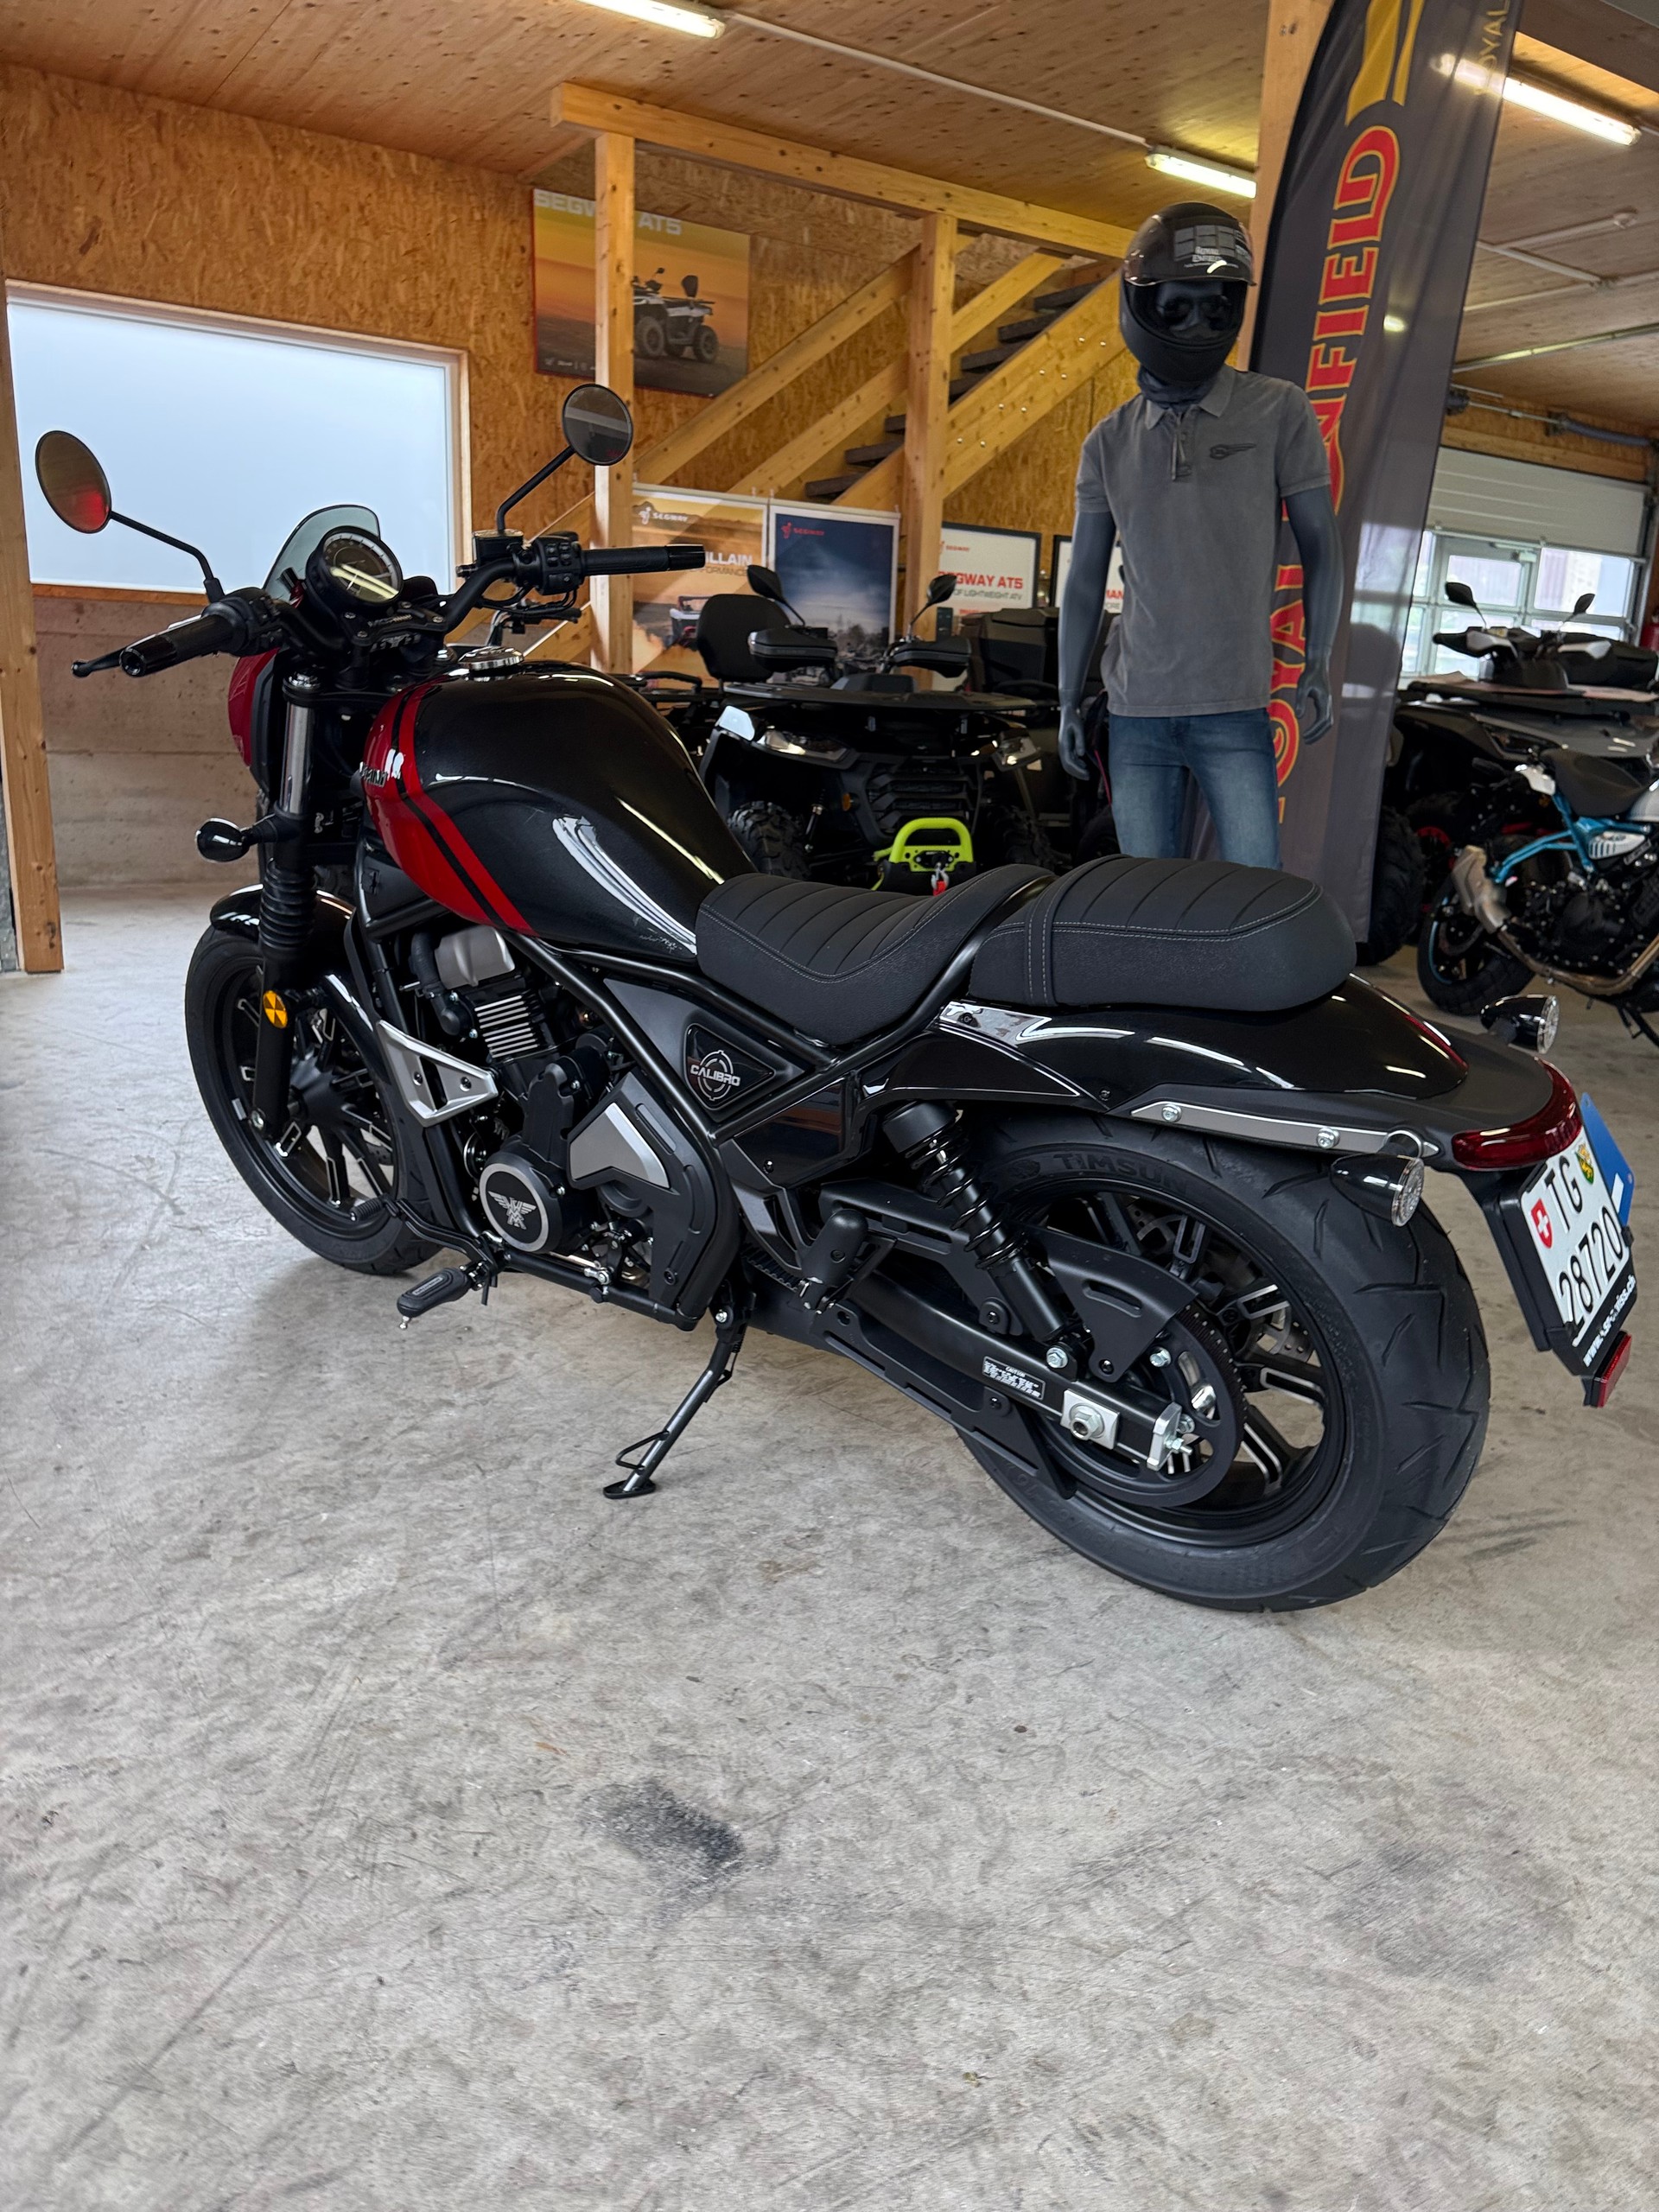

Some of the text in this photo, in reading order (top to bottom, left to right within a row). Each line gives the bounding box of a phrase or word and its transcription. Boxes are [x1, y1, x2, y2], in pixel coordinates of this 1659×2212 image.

[690, 1064, 741, 1087] CALIBRO
[1053, 1153, 1187, 1194] TIMSUN
[1544, 1154, 1583, 1232] TG
[1558, 1206, 1624, 1334] 28720
